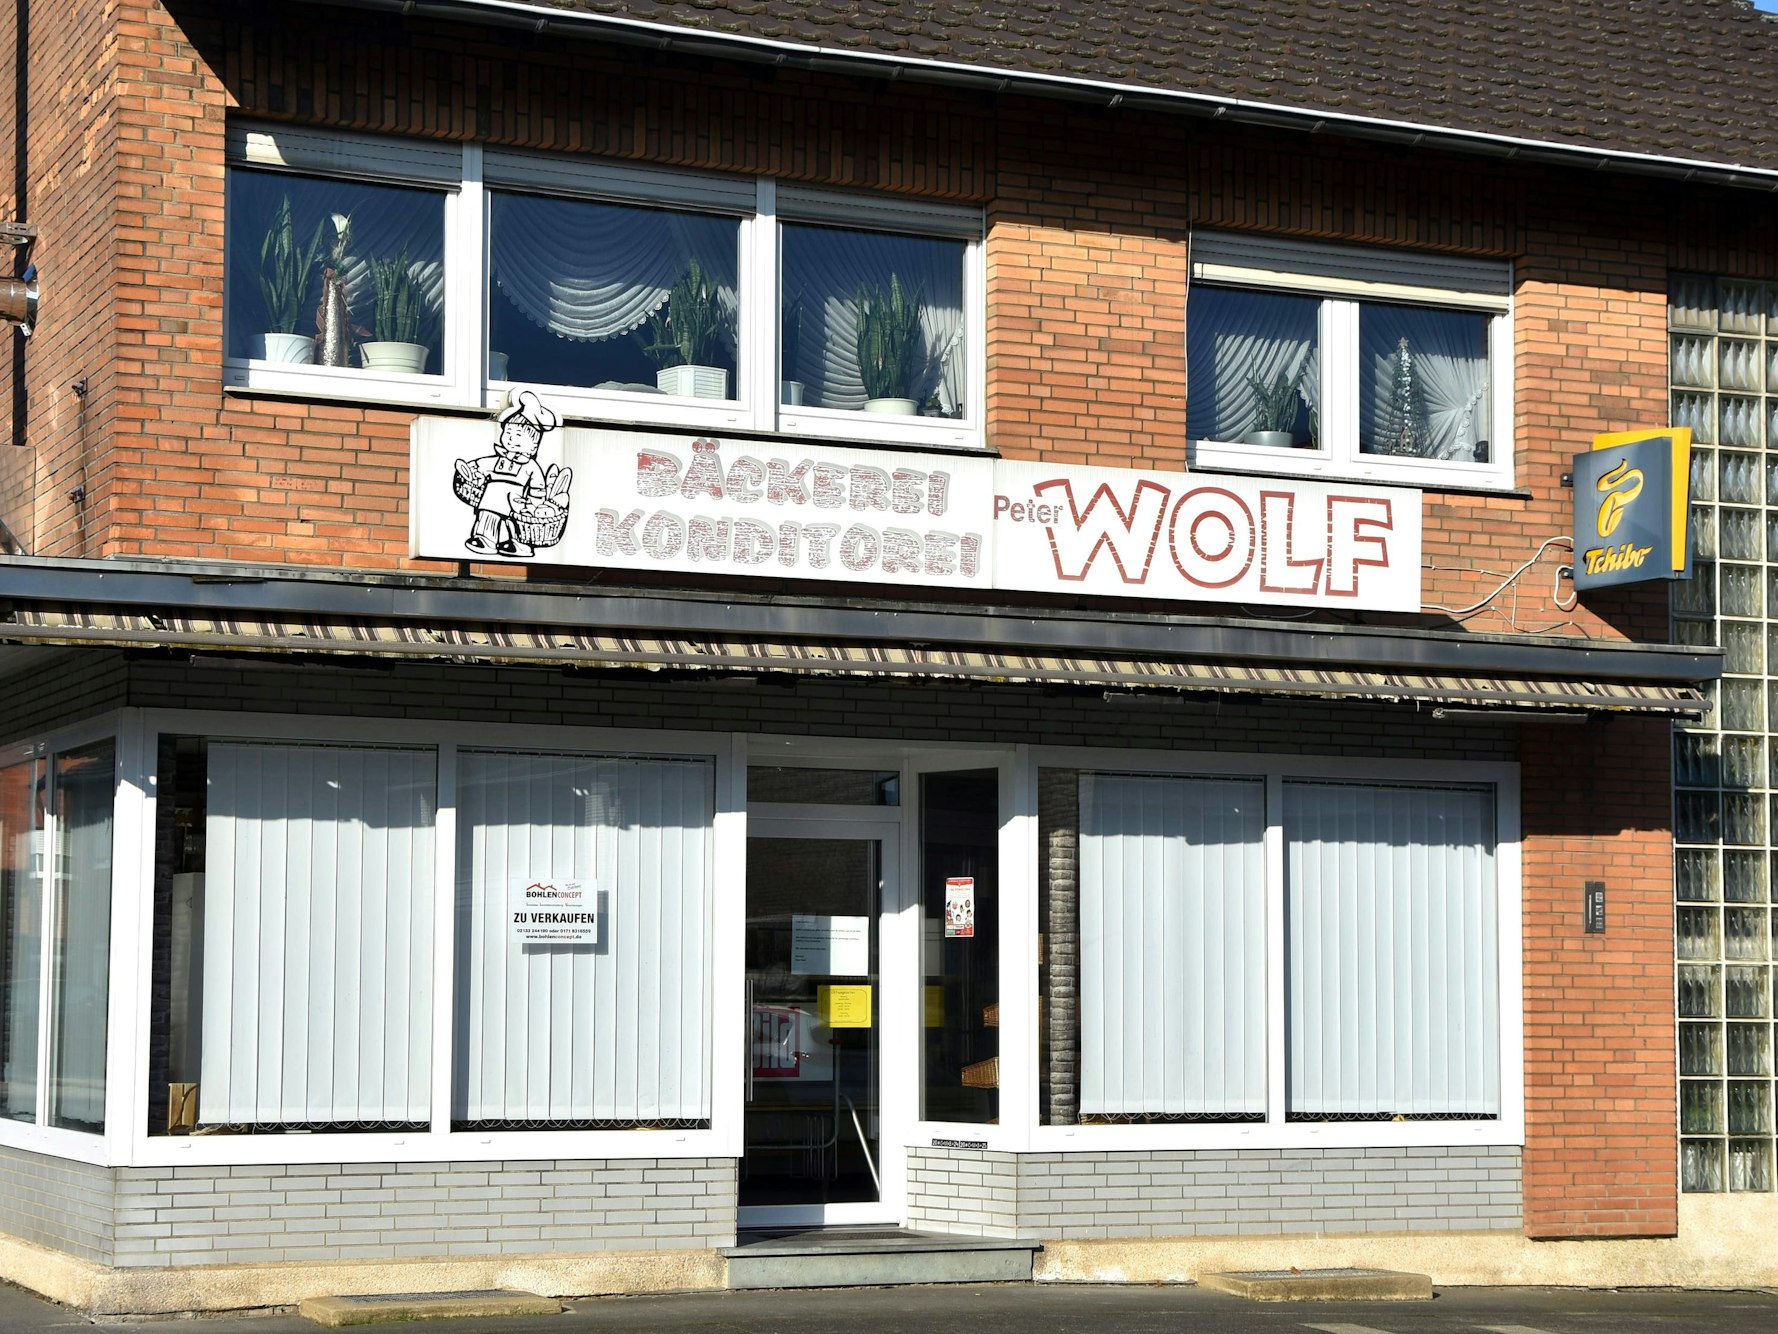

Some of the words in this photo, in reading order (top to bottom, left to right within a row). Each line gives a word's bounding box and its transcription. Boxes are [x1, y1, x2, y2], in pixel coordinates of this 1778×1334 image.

[637, 438, 951, 517] BÄCKEREI
[594, 507, 984, 578] KONDITOREI
[993, 495, 1063, 524] Peter
[1032, 478, 1393, 597] WOLF
[1585, 543, 1653, 575] Tchibo
[513, 912, 527, 923] ZU
[531, 912, 595, 924] VERKAUFEN
